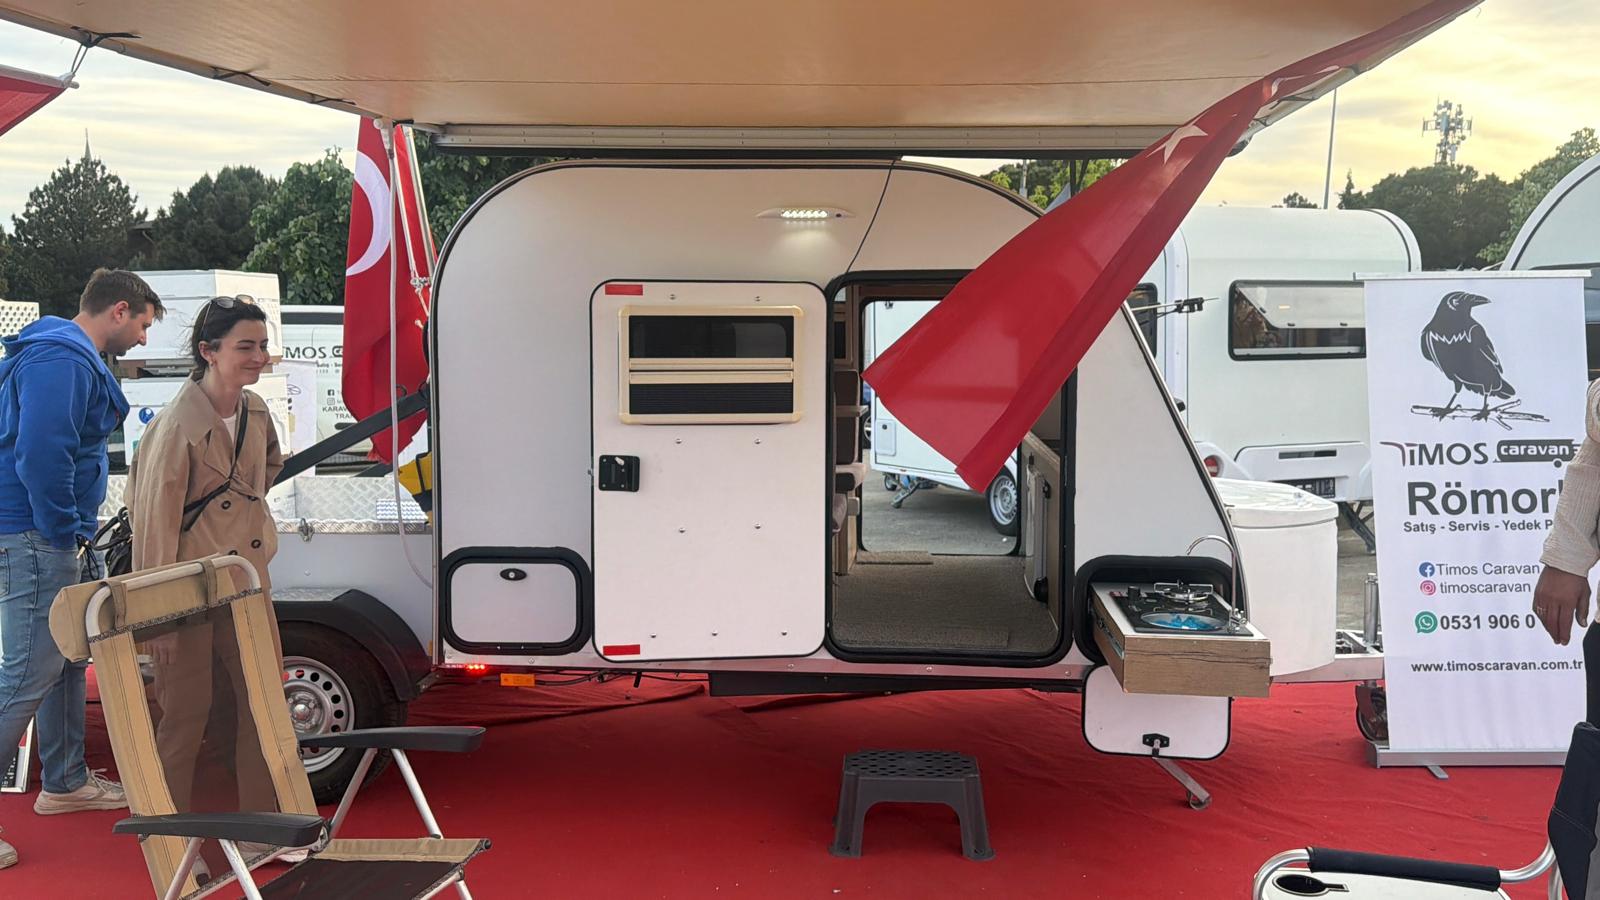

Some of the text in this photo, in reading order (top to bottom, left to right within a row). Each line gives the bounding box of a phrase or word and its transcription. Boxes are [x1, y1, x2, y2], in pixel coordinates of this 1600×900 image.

[1403, 521, 1436, 534] Satış
[1448, 520, 1490, 532] Servis
[1502, 519, 1541, 531] Yedek
[1436, 562, 1540, 576] Timos Caravan
[1440, 582, 1531, 594] timoscaravan
[1440, 615, 1481, 630] 0531
[1488, 614, 1519, 629] 906
[1411, 659, 1583, 672] www.timoscaravan.com.tr
